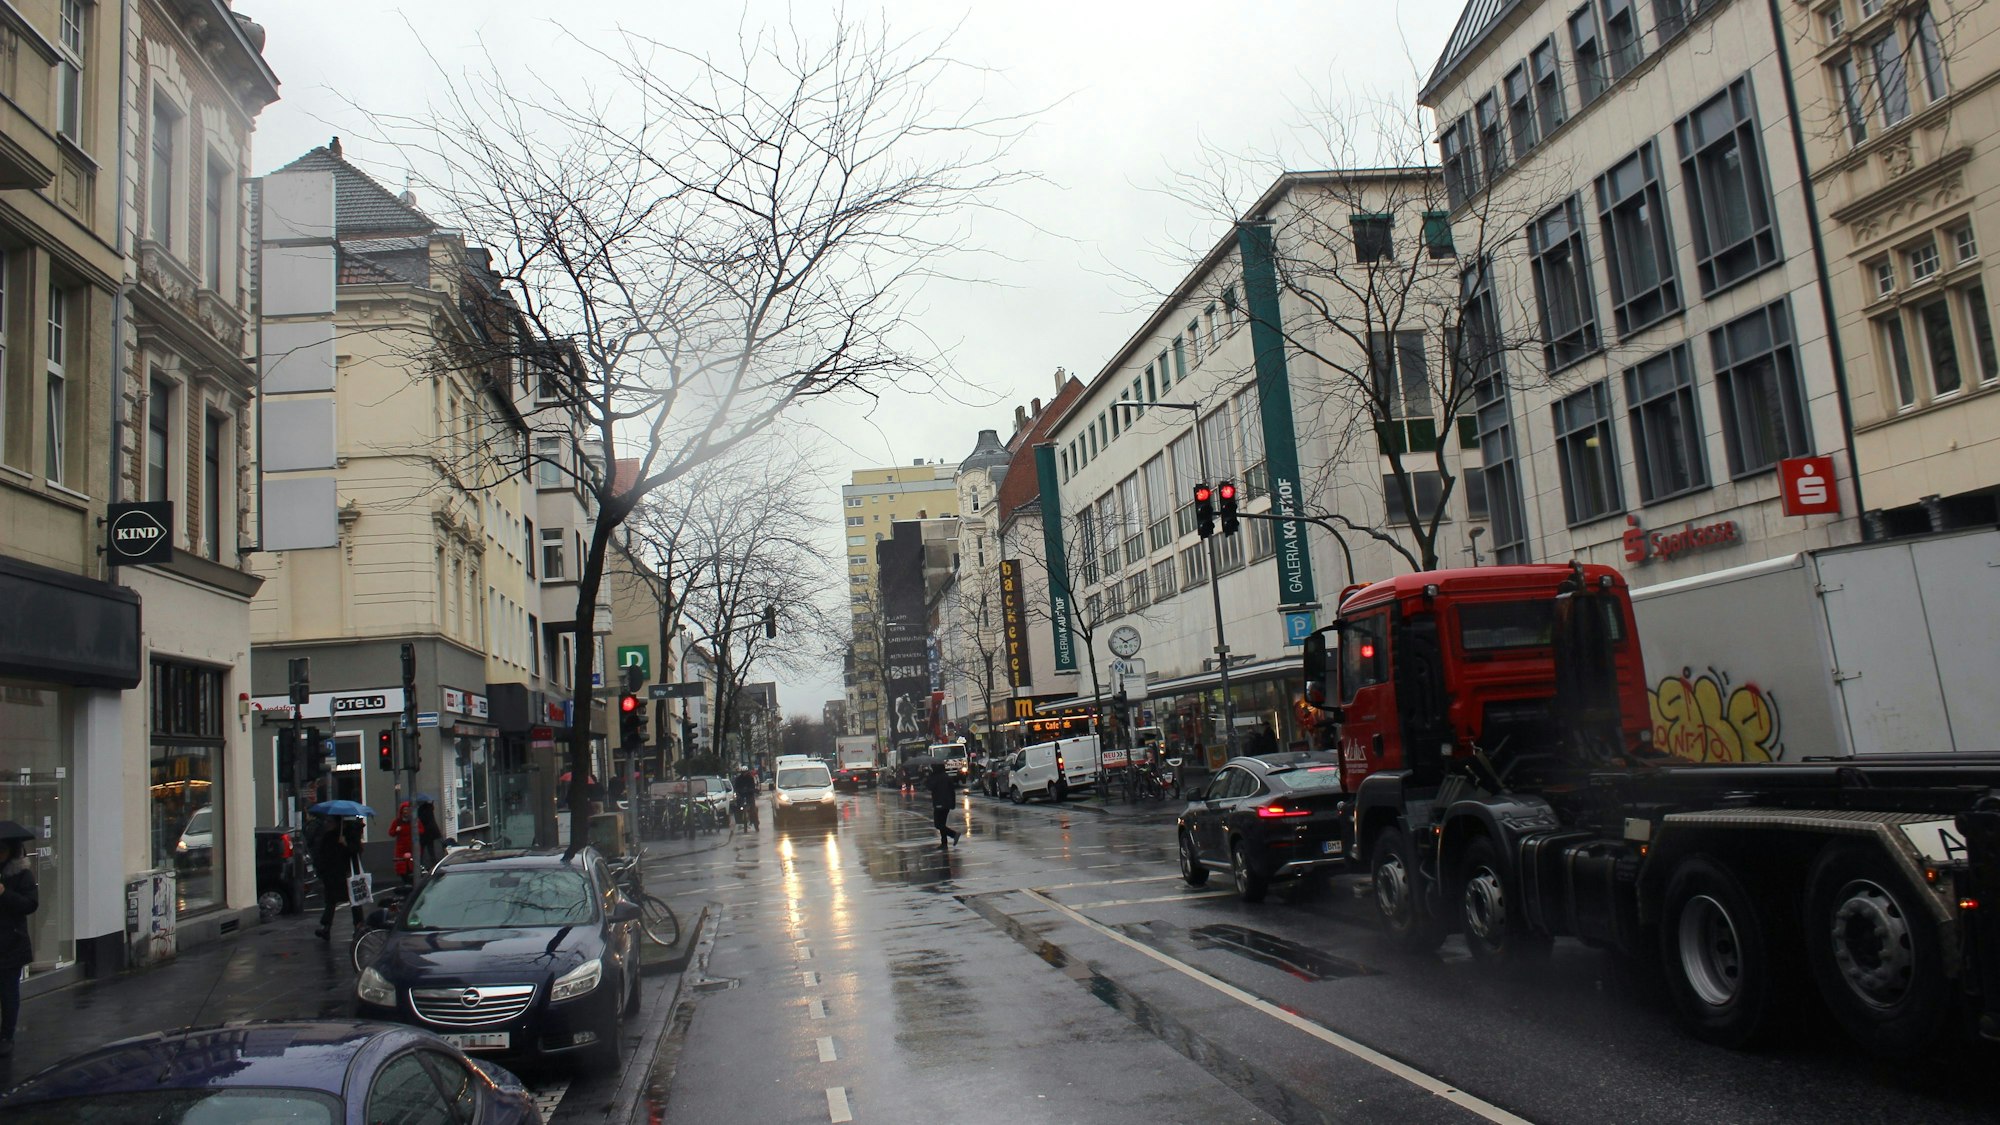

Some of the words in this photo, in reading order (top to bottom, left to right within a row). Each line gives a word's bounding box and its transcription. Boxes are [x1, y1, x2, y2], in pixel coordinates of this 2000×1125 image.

[117, 527, 159, 540] KIND
[1650, 520, 1737, 561] Sparkasse
[1285, 539, 1303, 593] GALERIA
[1060, 633, 1071, 664] GALERIA
